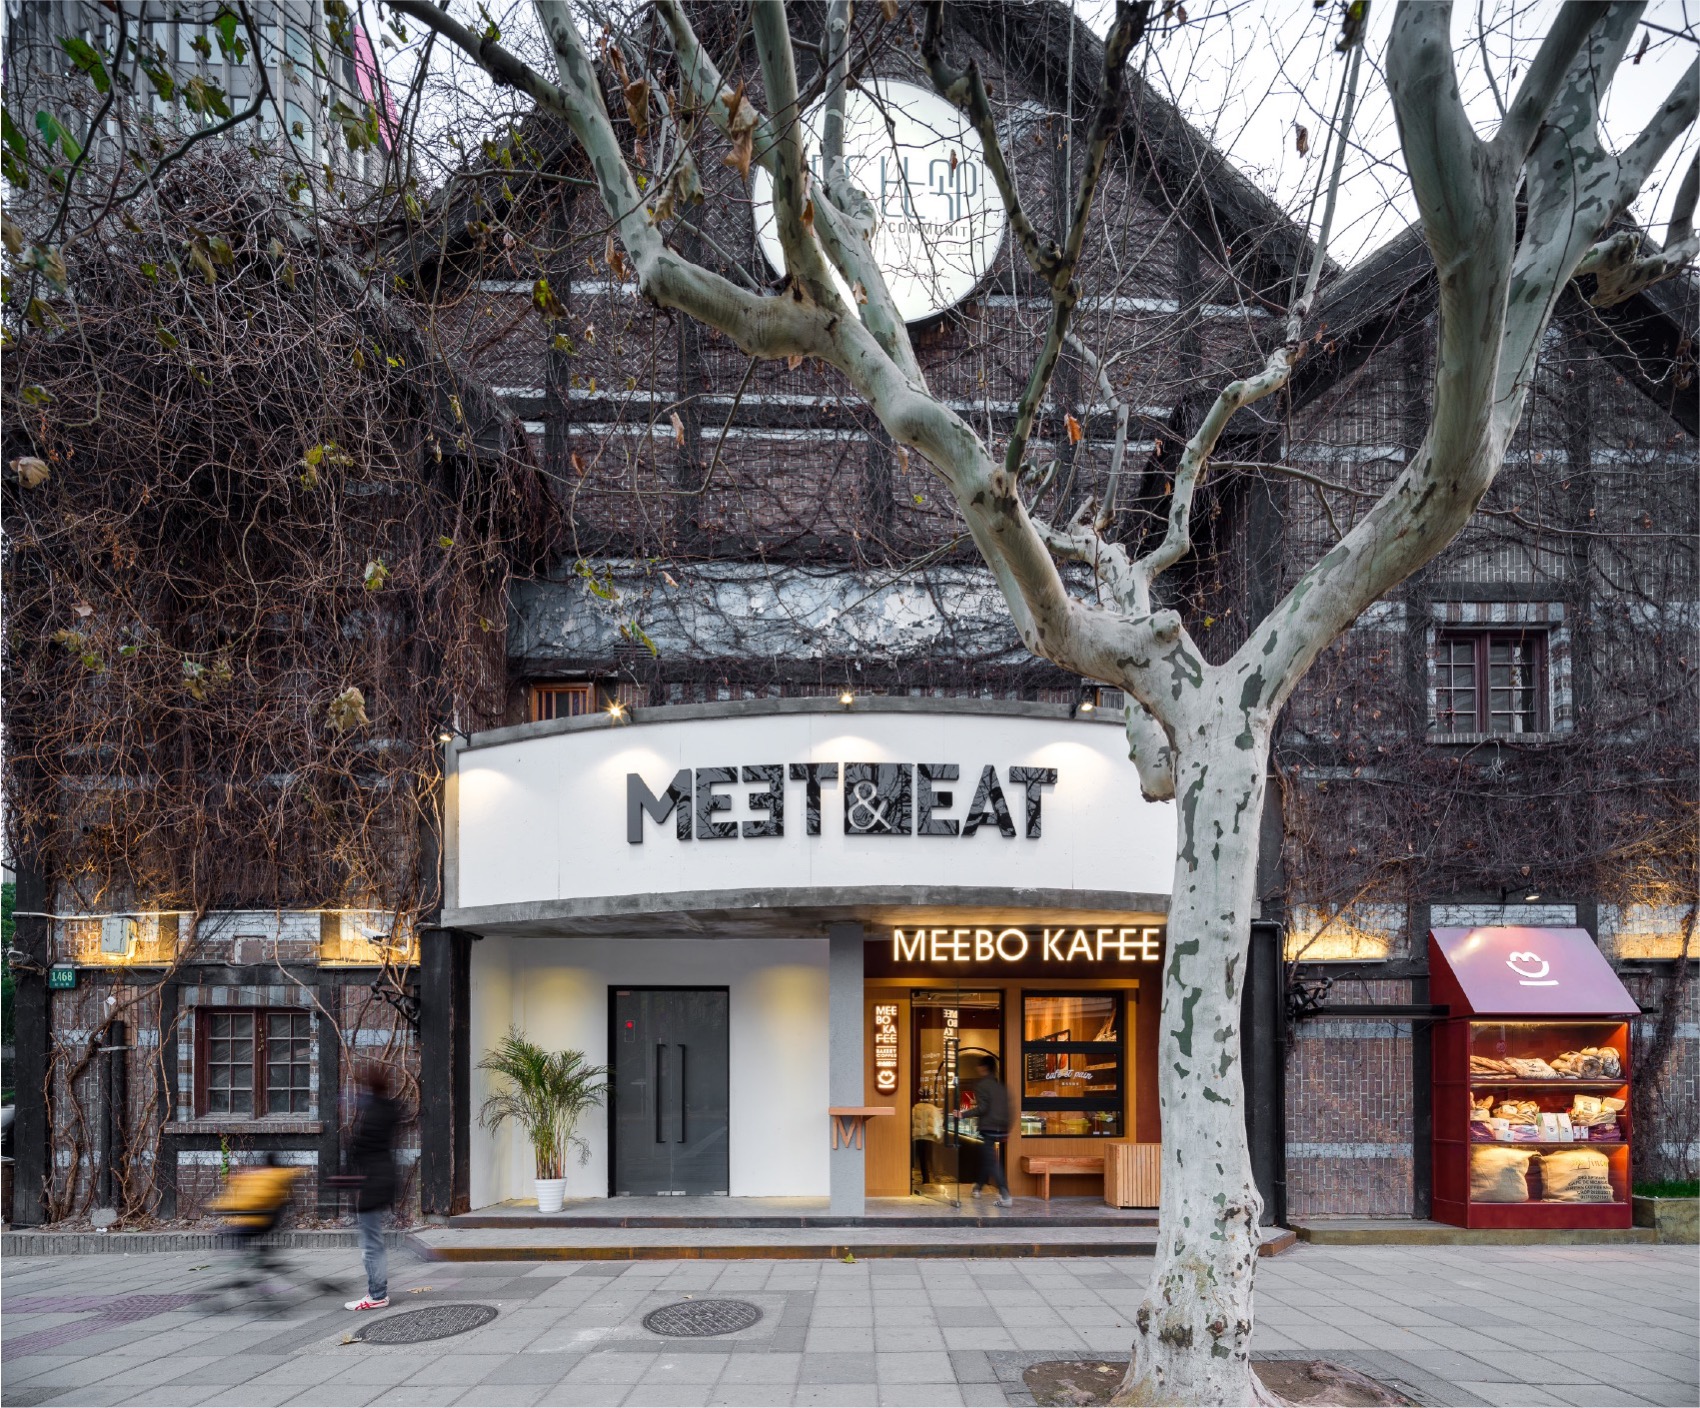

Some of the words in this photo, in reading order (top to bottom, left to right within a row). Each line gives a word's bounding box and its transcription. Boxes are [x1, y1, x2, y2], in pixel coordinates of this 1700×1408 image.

[893, 928, 1029, 962] MEEBO
[1043, 928, 1160, 962] KAFEE
[51, 971, 73, 982] 1468
[875, 1005, 897, 1016] MEE
[875, 1015, 892, 1025] BO
[882, 1024, 897, 1034] KA
[875, 1033, 897, 1044] FEE
